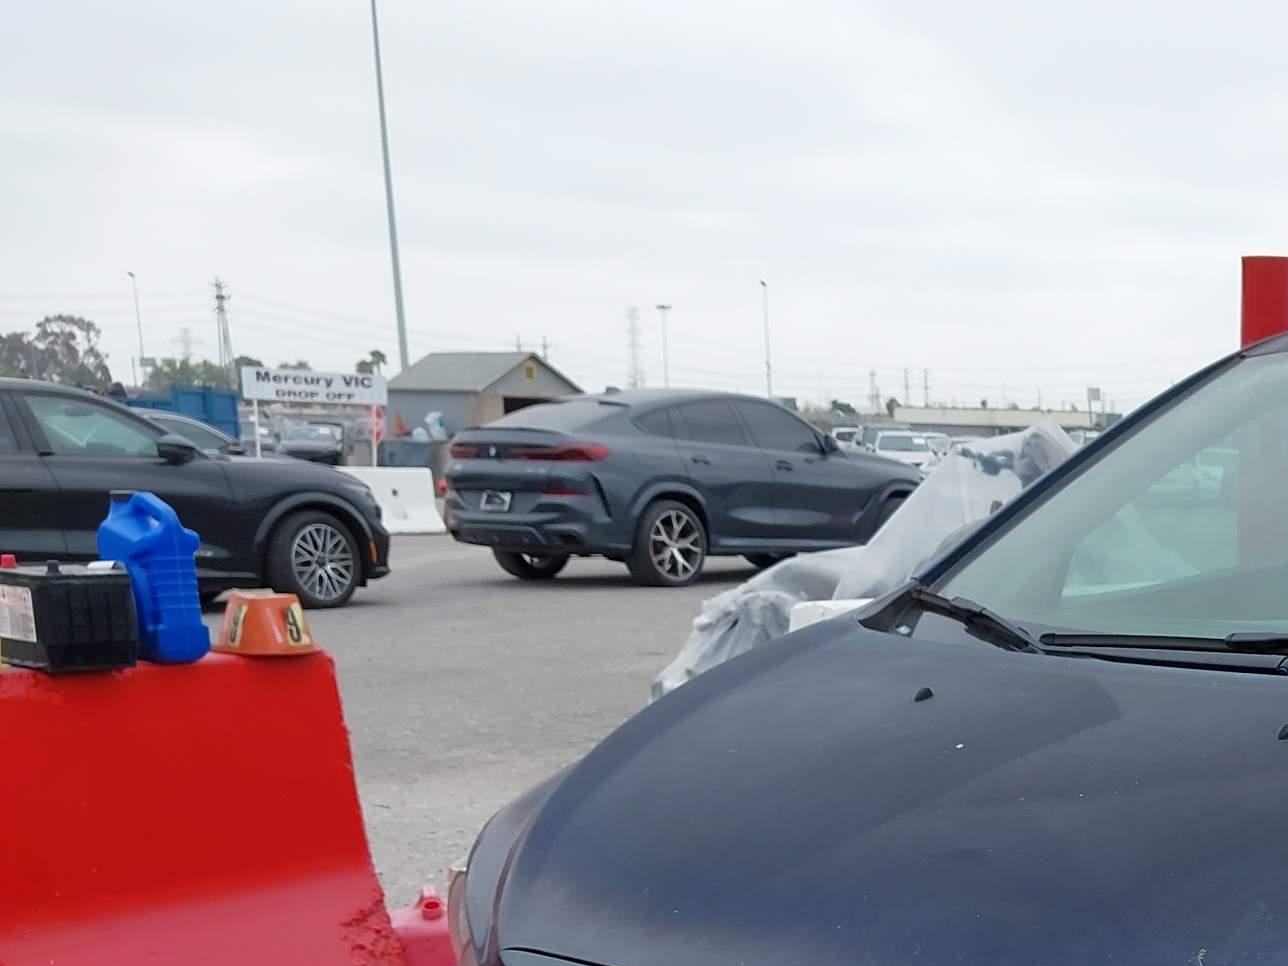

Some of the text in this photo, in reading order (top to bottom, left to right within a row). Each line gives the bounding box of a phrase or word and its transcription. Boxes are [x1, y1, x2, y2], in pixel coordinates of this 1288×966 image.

[256, 370, 373, 389] Mercury VIC
[275, 389, 355, 401] DROP OFF
